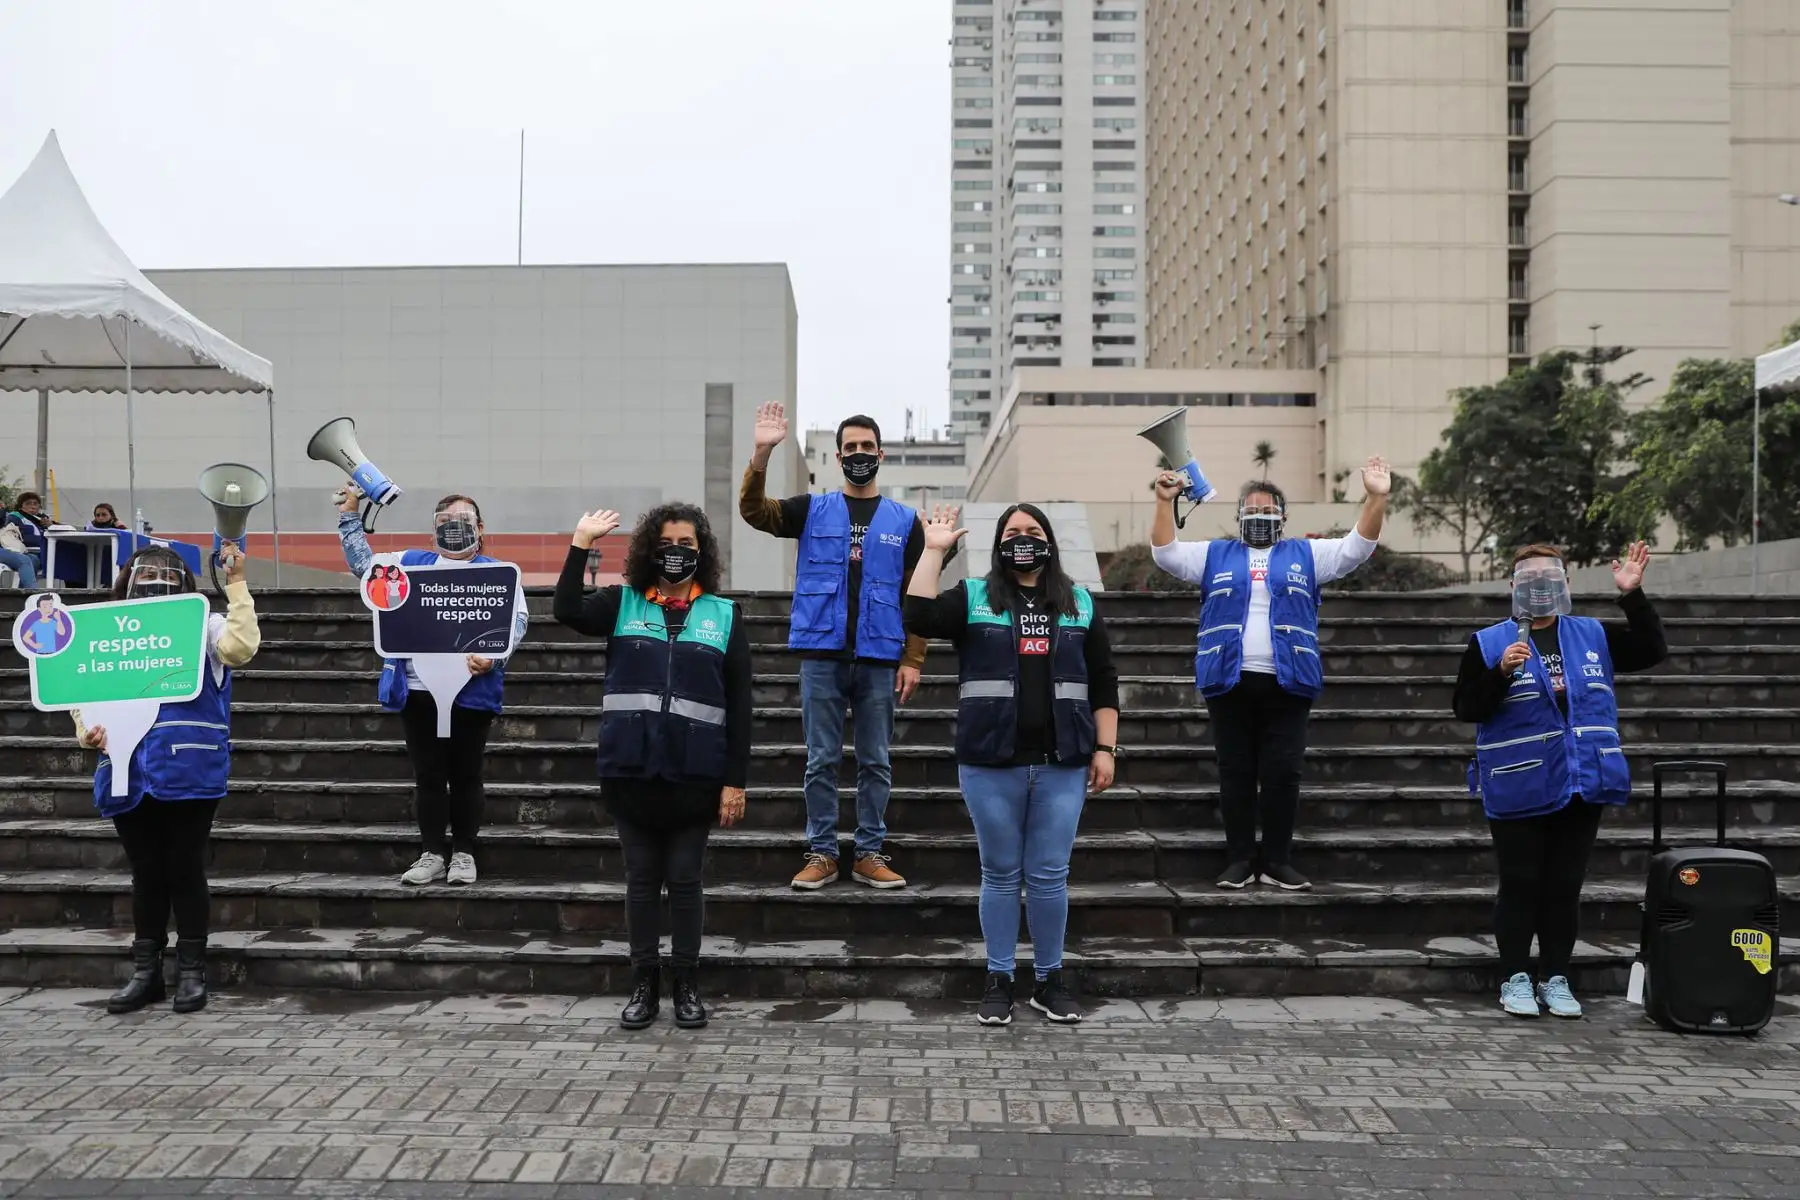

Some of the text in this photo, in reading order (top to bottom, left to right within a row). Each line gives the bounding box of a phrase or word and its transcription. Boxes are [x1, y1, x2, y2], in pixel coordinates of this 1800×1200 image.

[419, 583, 507, 595] Todas las mujeres
[421, 596, 505, 607] merecemos
[436, 608, 491, 624] respeto
[114, 615, 141, 632] Yo
[695, 631, 724, 643] LIMA
[89, 634, 172, 655] respeto
[77, 656, 183, 673] a las mujeres
[1734, 932, 1763, 945] 6000
